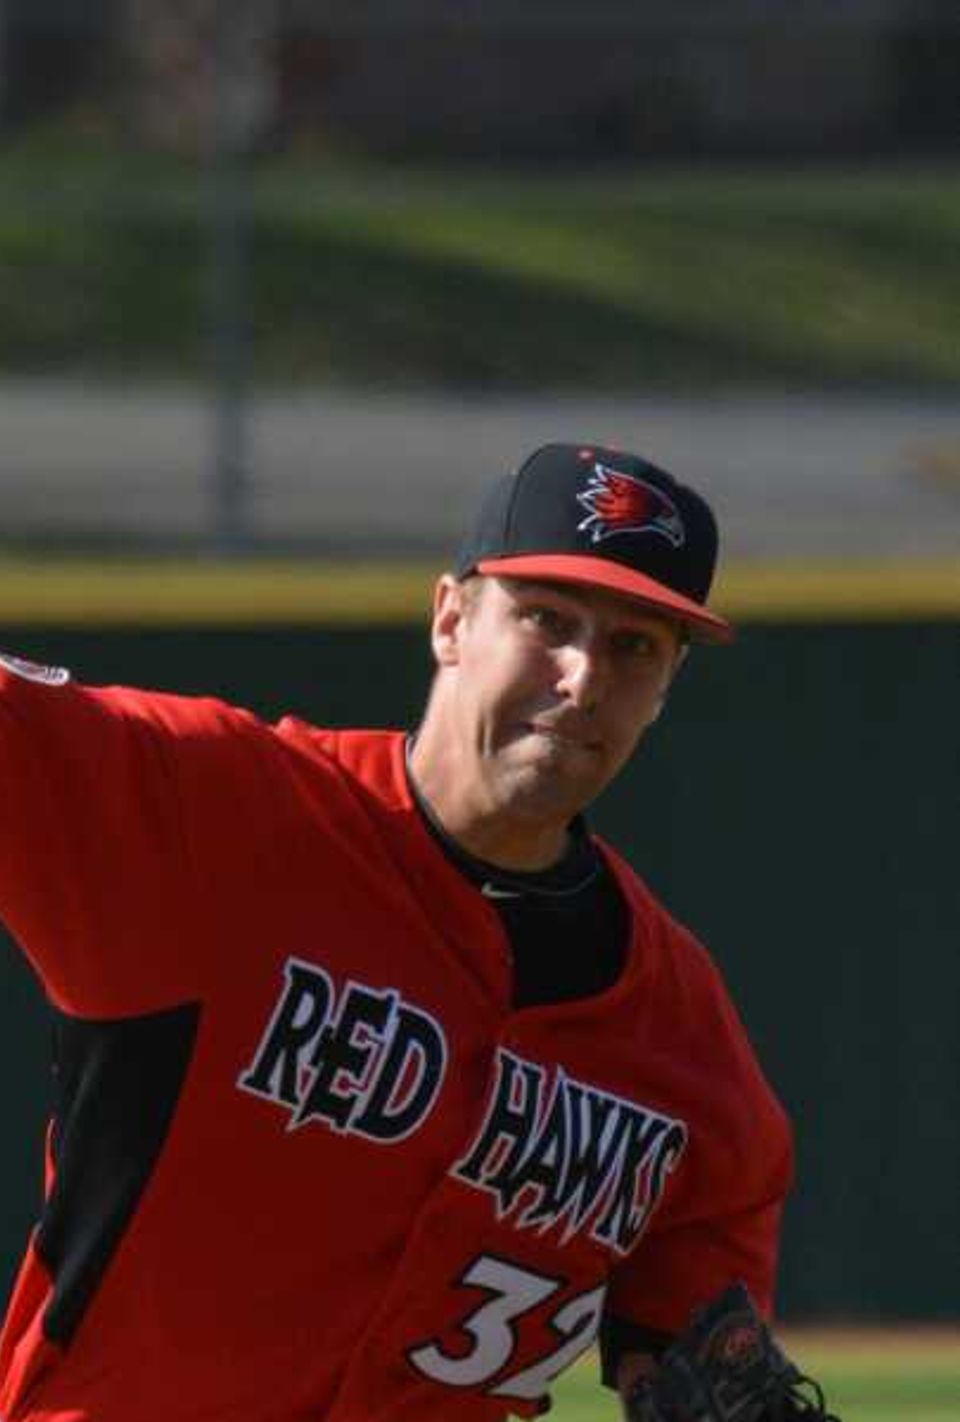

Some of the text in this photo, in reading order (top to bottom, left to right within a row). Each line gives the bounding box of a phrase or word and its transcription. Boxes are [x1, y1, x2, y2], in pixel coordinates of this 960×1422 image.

[236, 956, 689, 1257] RED HAWKS
[407, 1253, 607, 1420] 32
